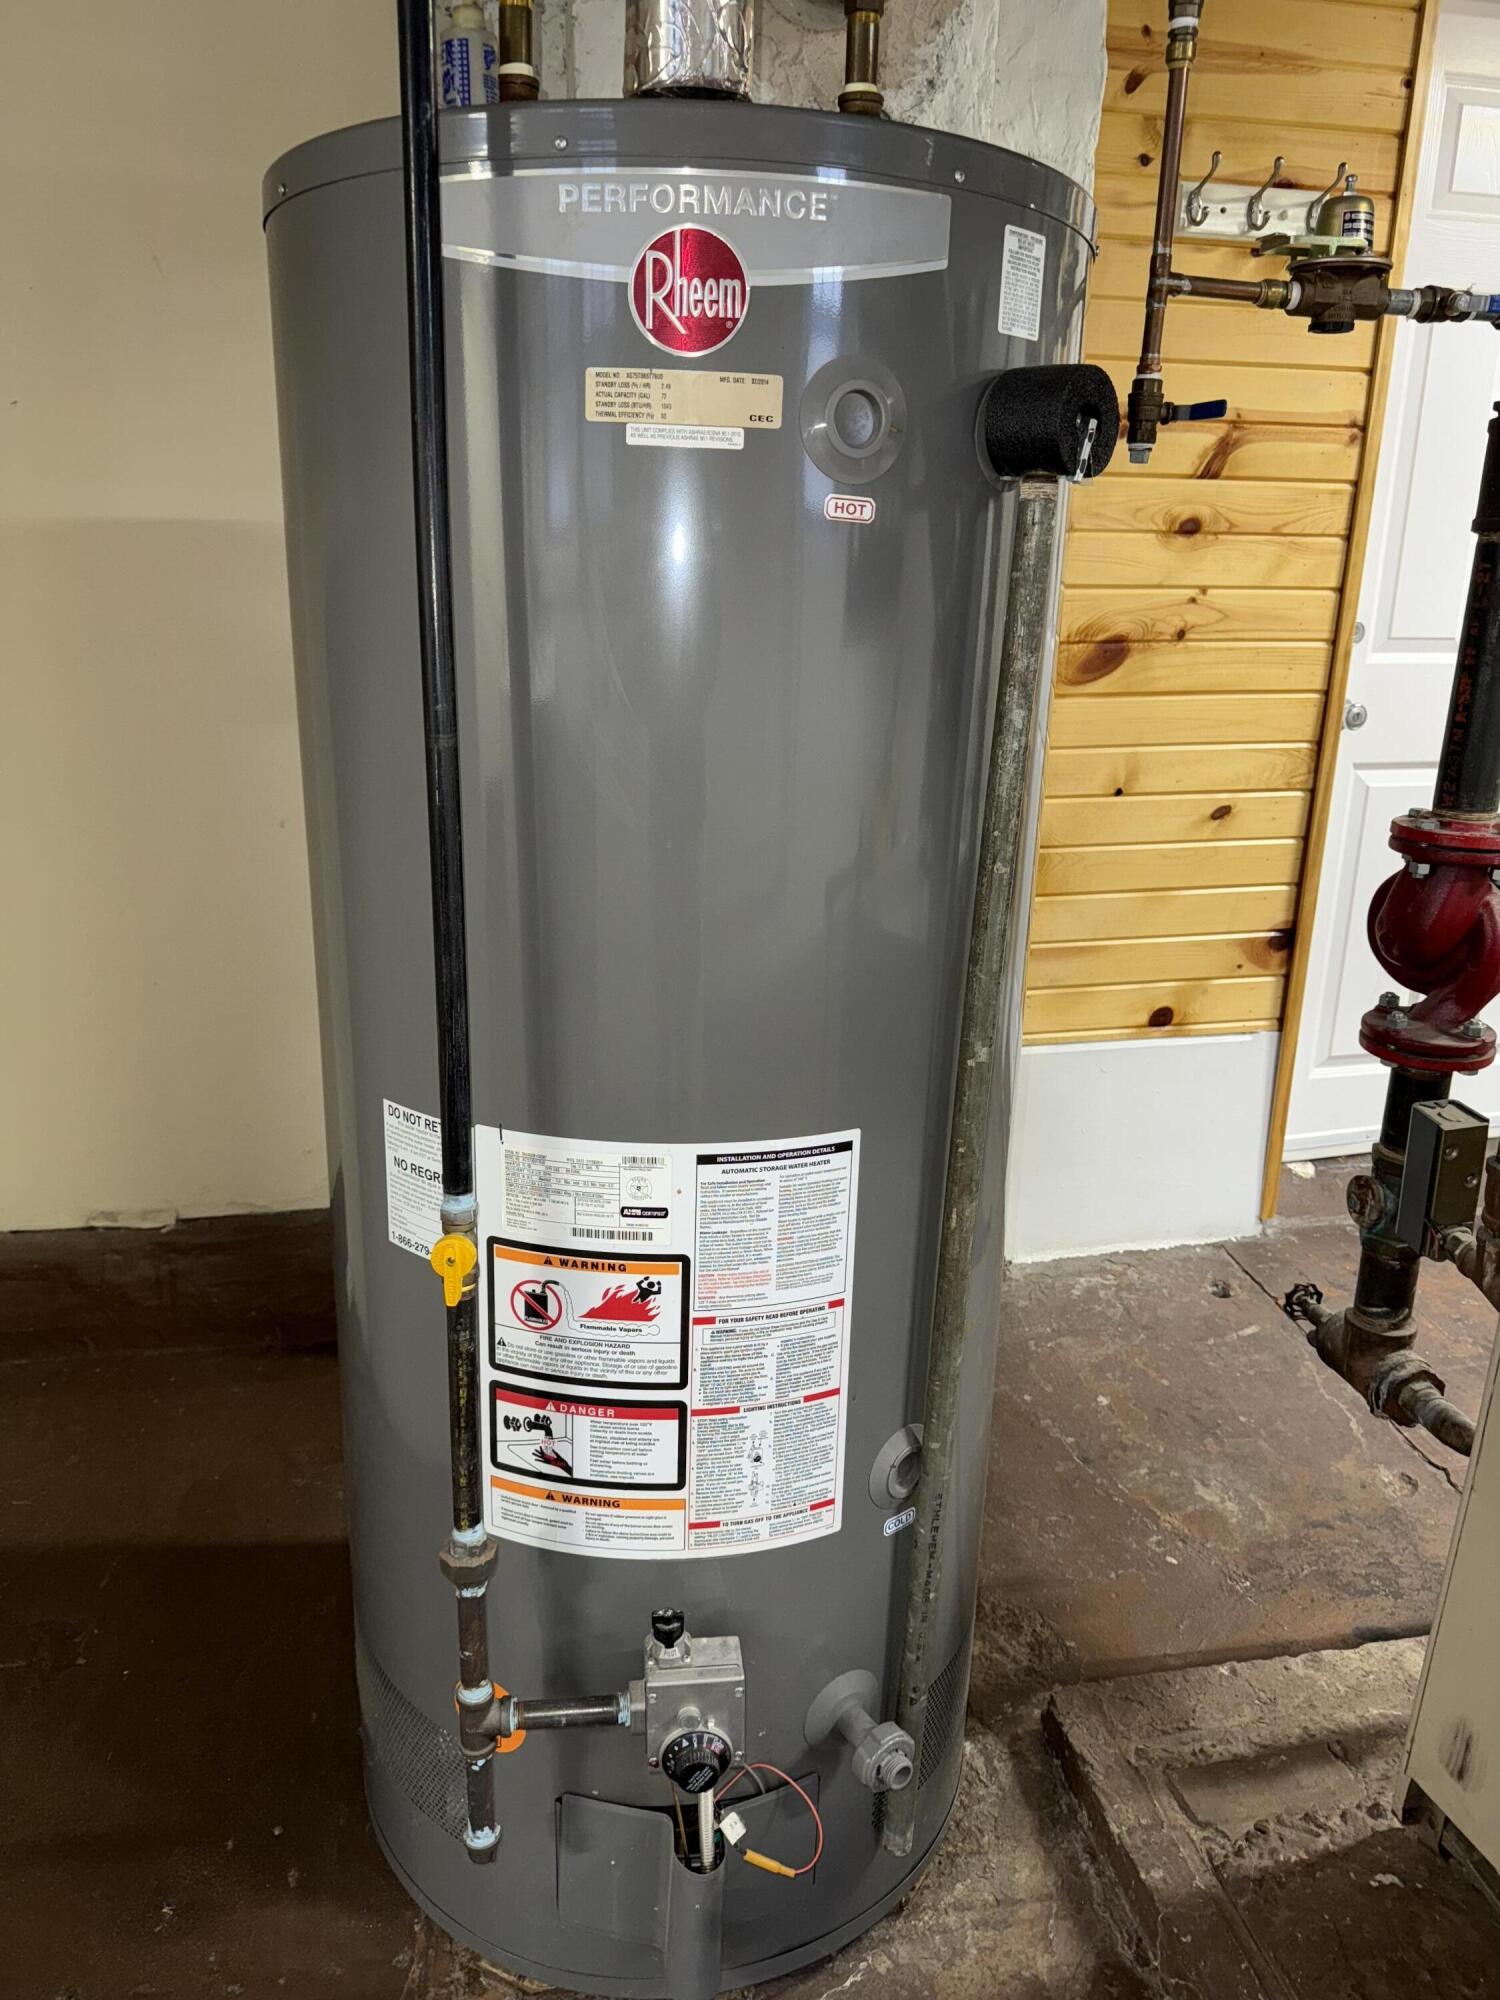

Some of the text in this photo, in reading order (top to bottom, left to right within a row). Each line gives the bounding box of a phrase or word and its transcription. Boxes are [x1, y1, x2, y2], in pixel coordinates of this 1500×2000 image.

[558, 183, 827, 221] PERFORMANCE
[645, 229, 741, 335] Rheem
[834, 502, 866, 516] HOT
[388, 1104, 401, 1119] DO
[403, 1109, 421, 1127] NOT
[777, 1149, 811, 1159] OPERATION
[812, 1146, 835, 1154] DETAILS
[394, 1155, 408, 1171] NO
[559, 1258, 627, 1272] WARNING
[799, 1306, 825, 1316] OPERATING
[580, 1323, 642, 1334] Flammable Vapors
[568, 1338, 603, 1347] EXPLOSION
[593, 1348, 609, 1356] injury
[560, 1404, 615, 1417] DANGER
[562, 1494, 621, 1508] WARNING
[888, 1513, 912, 1530] COLD
